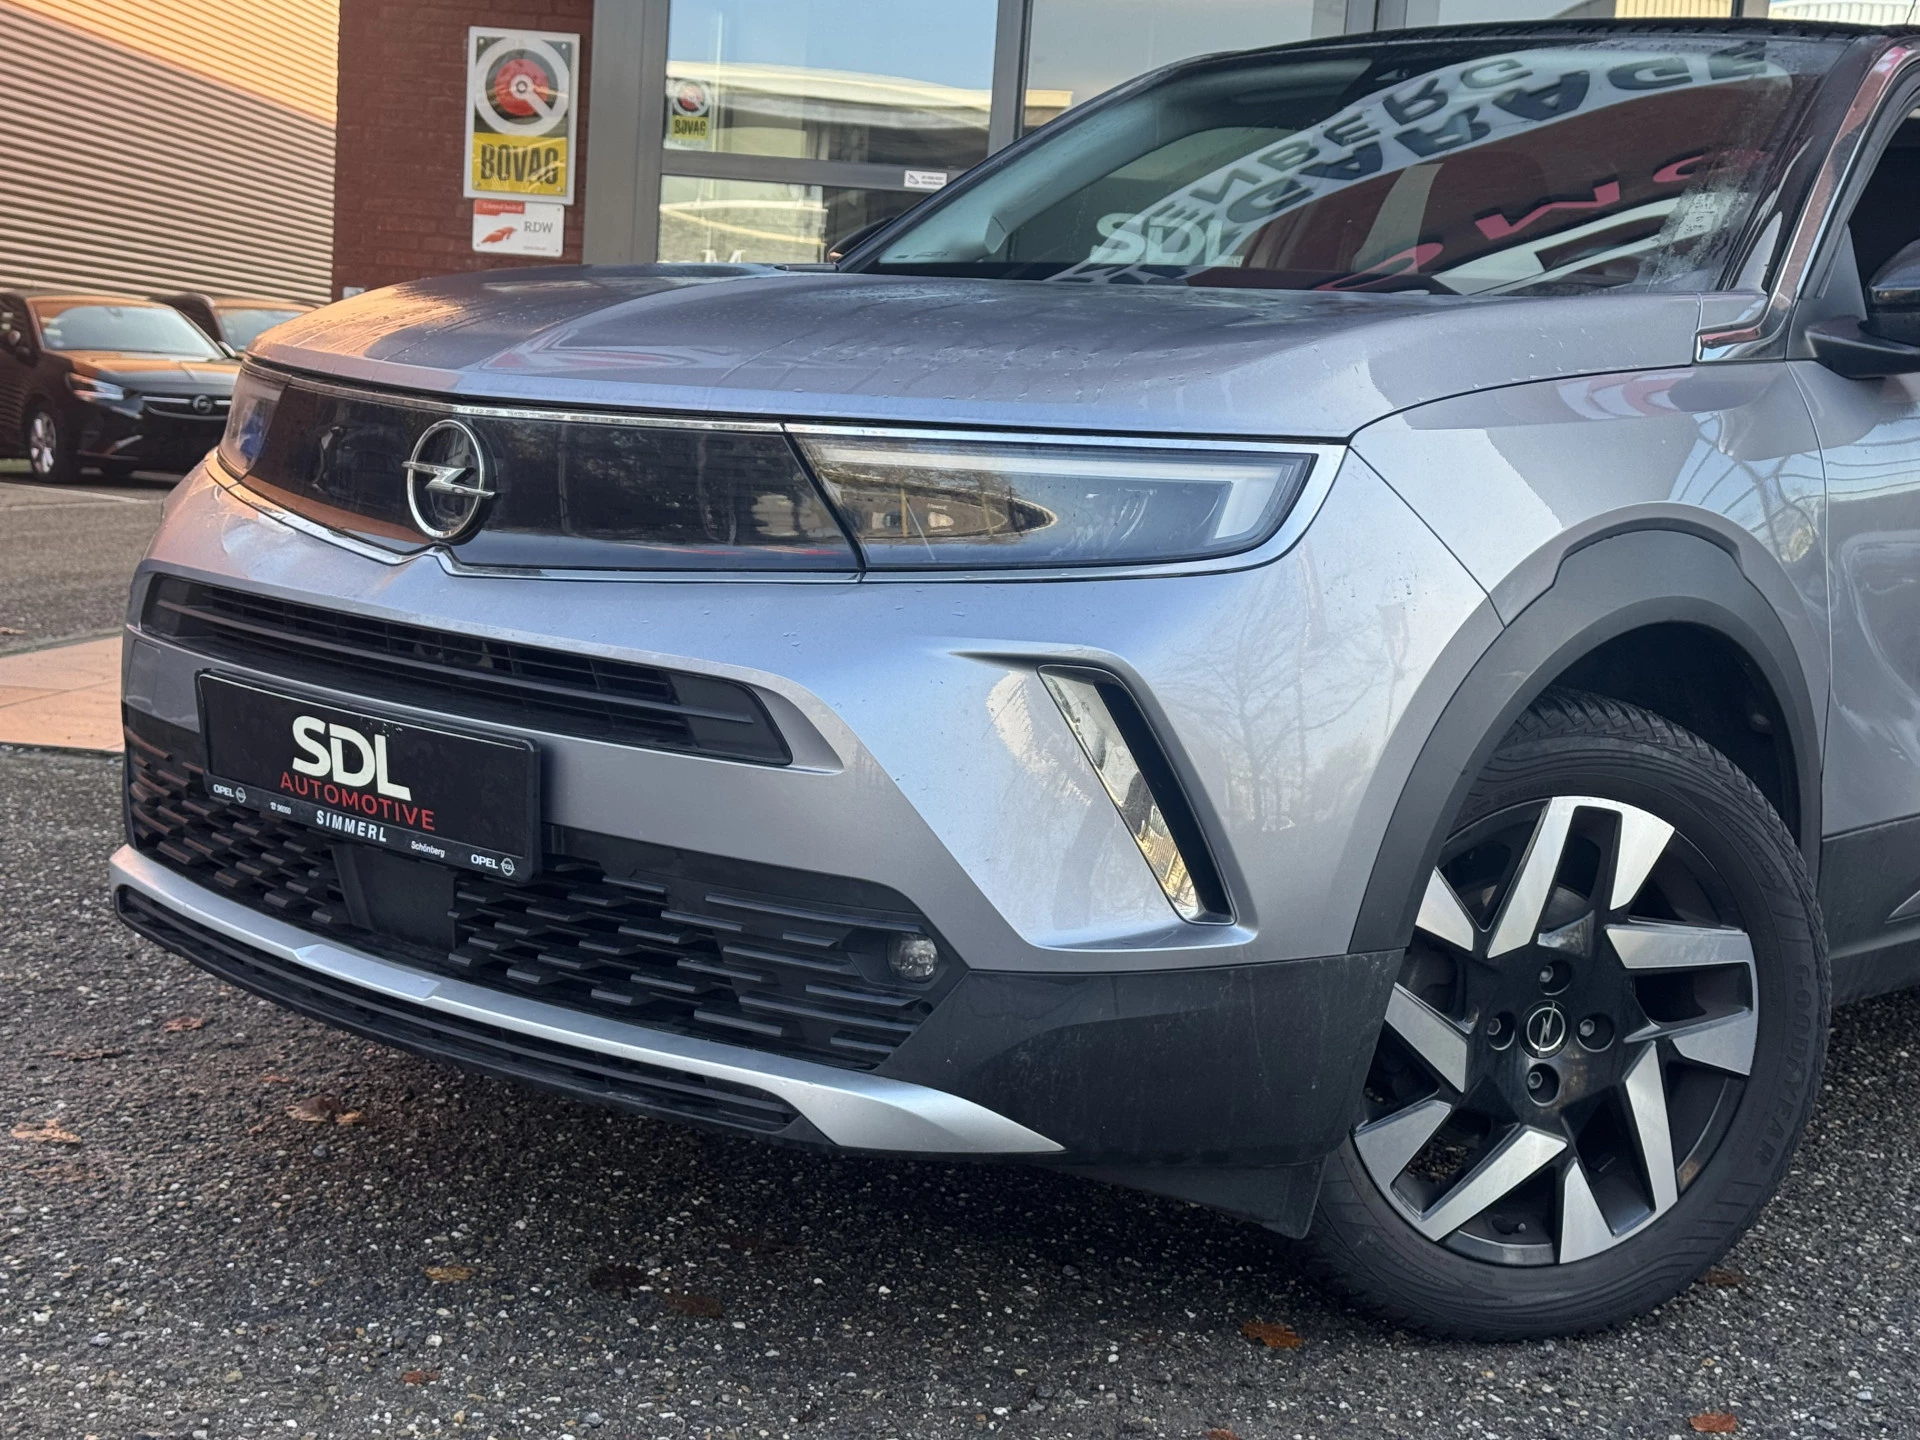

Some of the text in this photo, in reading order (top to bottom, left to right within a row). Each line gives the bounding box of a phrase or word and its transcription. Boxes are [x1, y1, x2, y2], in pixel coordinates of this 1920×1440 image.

[674, 118, 707, 137] BOVAG
[481, 143, 559, 185] BOVAG
[523, 220, 554, 233] RDW
[1090, 213, 1244, 269] SDL
[292, 715, 412, 801] SDL
[212, 783, 235, 798] OPEL
[316, 809, 387, 843] SIMMERL
[410, 840, 446, 859] Schönberg
[470, 854, 499, 870] OPEL
[280, 771, 436, 831] AUTOMOTIVE
[1755, 963, 1812, 1167] GOODYEAR
